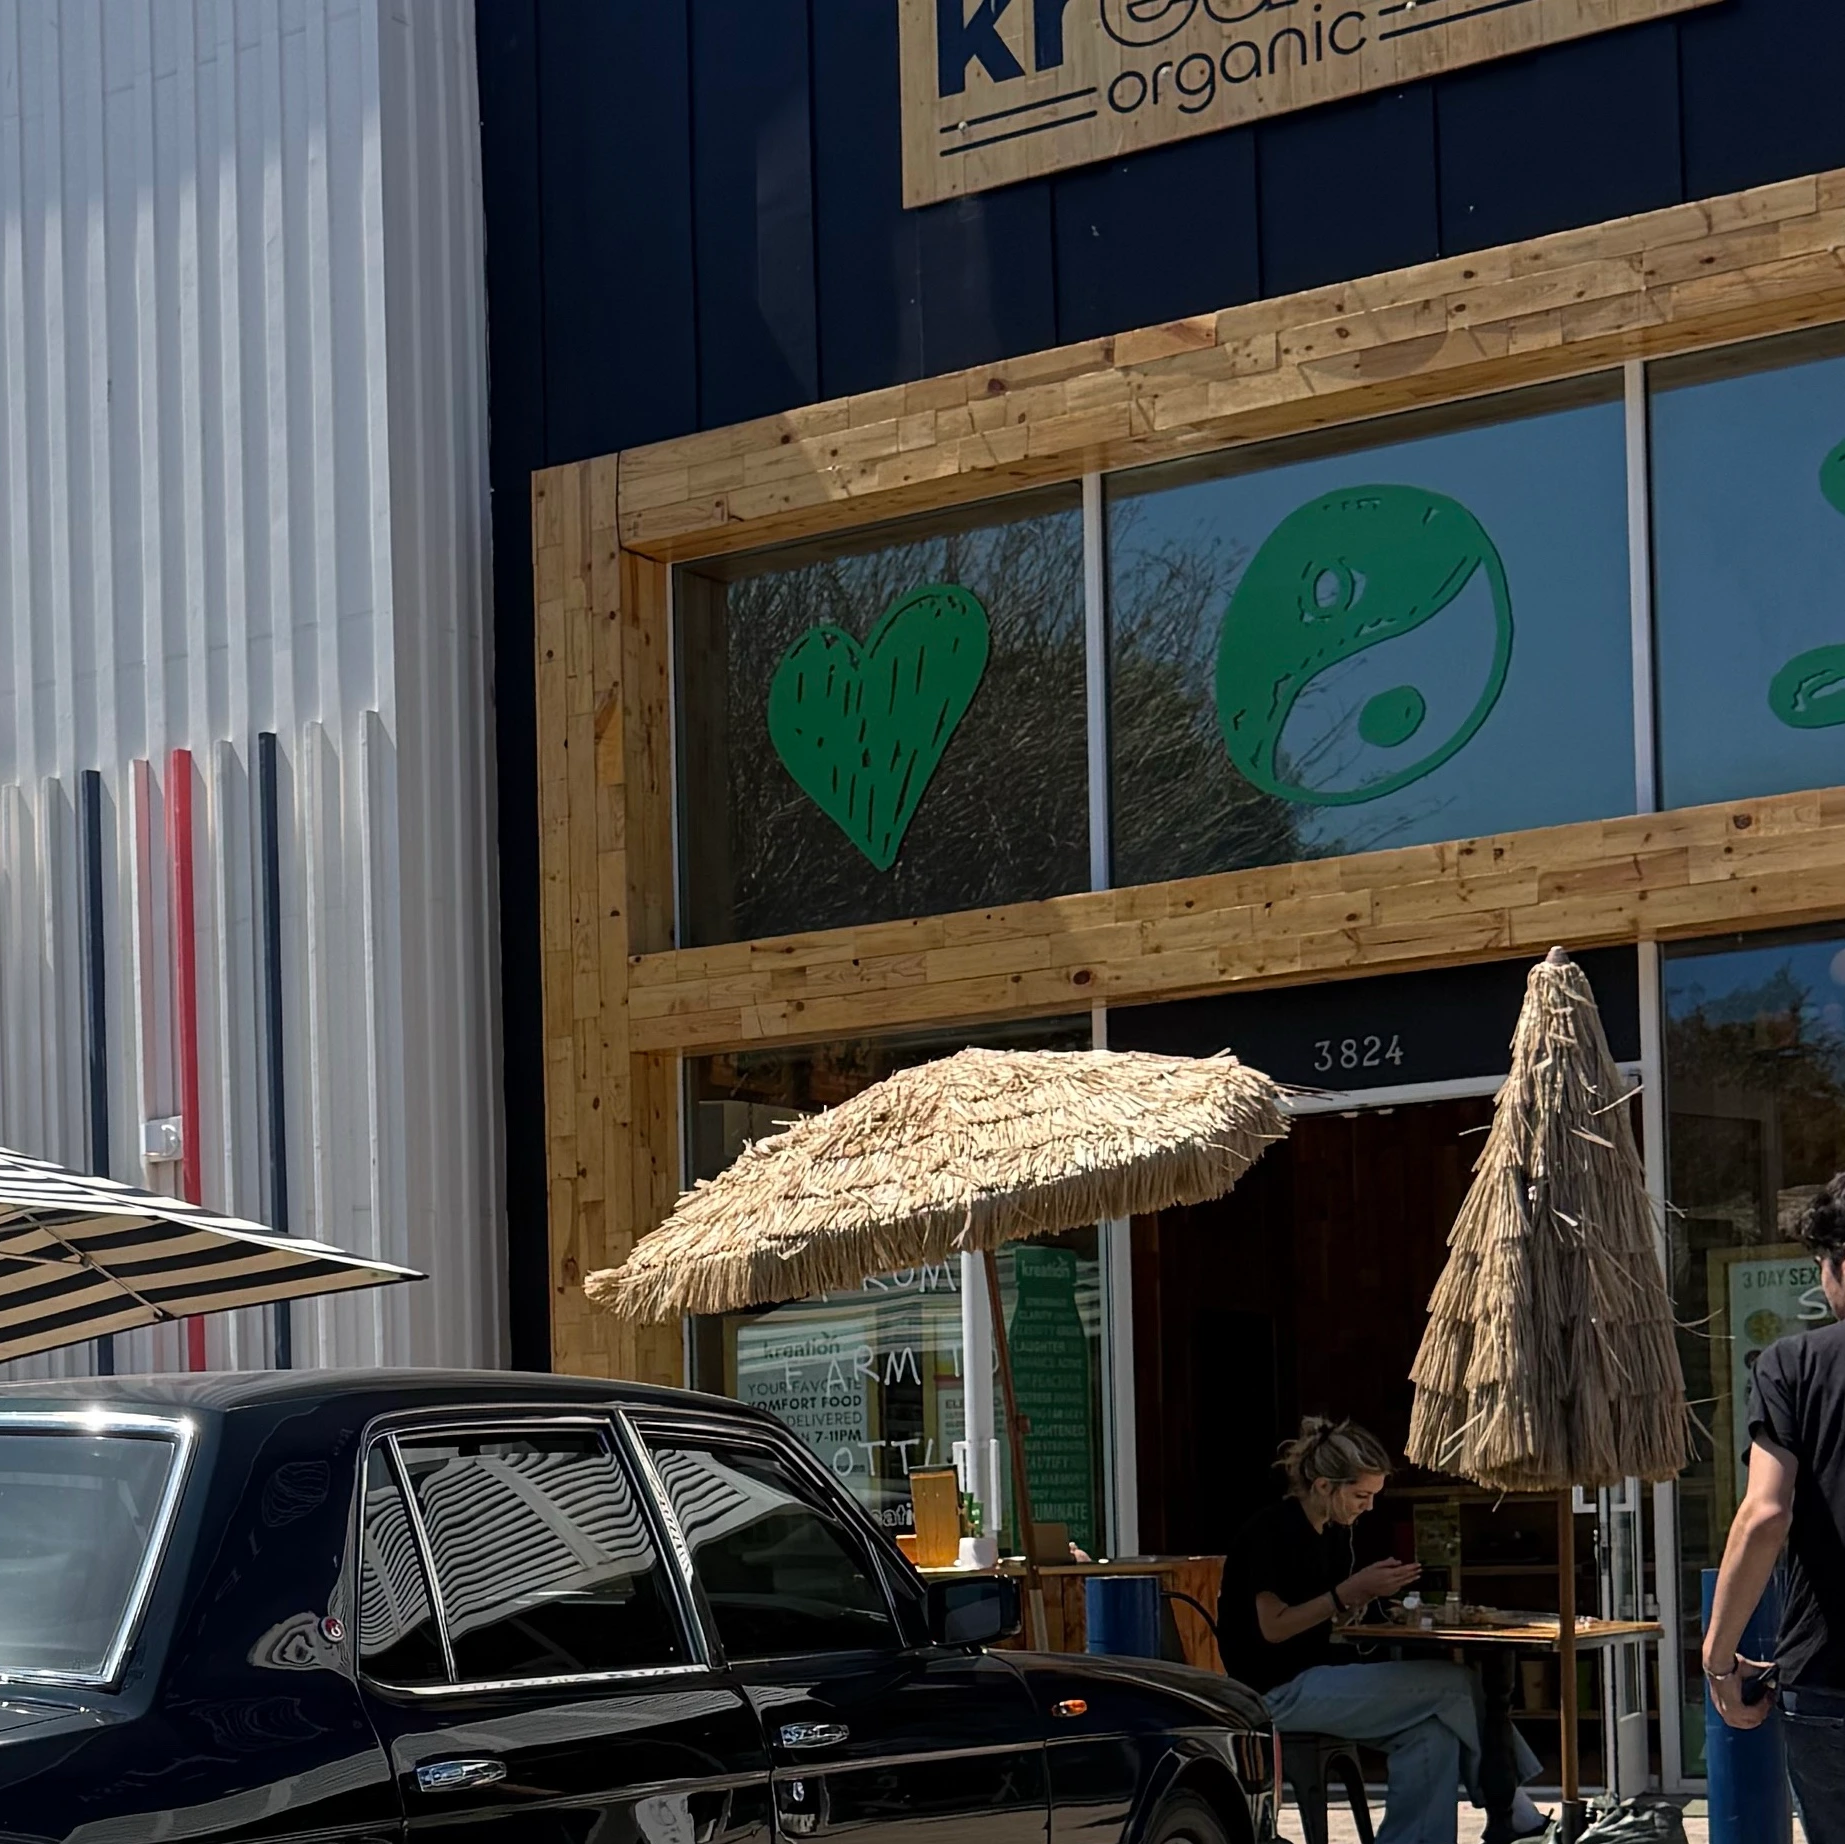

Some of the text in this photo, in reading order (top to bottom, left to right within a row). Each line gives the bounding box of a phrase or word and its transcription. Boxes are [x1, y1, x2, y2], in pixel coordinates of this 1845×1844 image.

[1108, 4, 1366, 113] organic
[1314, 1035, 1404, 1071] 3824
[1742, 1271, 1752, 1289] 3
[1757, 1269, 1785, 1288] DAY
[763, 1338, 841, 1359] kreation
[785, 1345, 922, 1397] FARM
[748, 1377, 862, 1396] YOUR FAVORTE
[821, 1395, 862, 1408] FOOD
[787, 1411, 862, 1427] DELIVERED
[815, 1429, 862, 1443] 7-11PM
